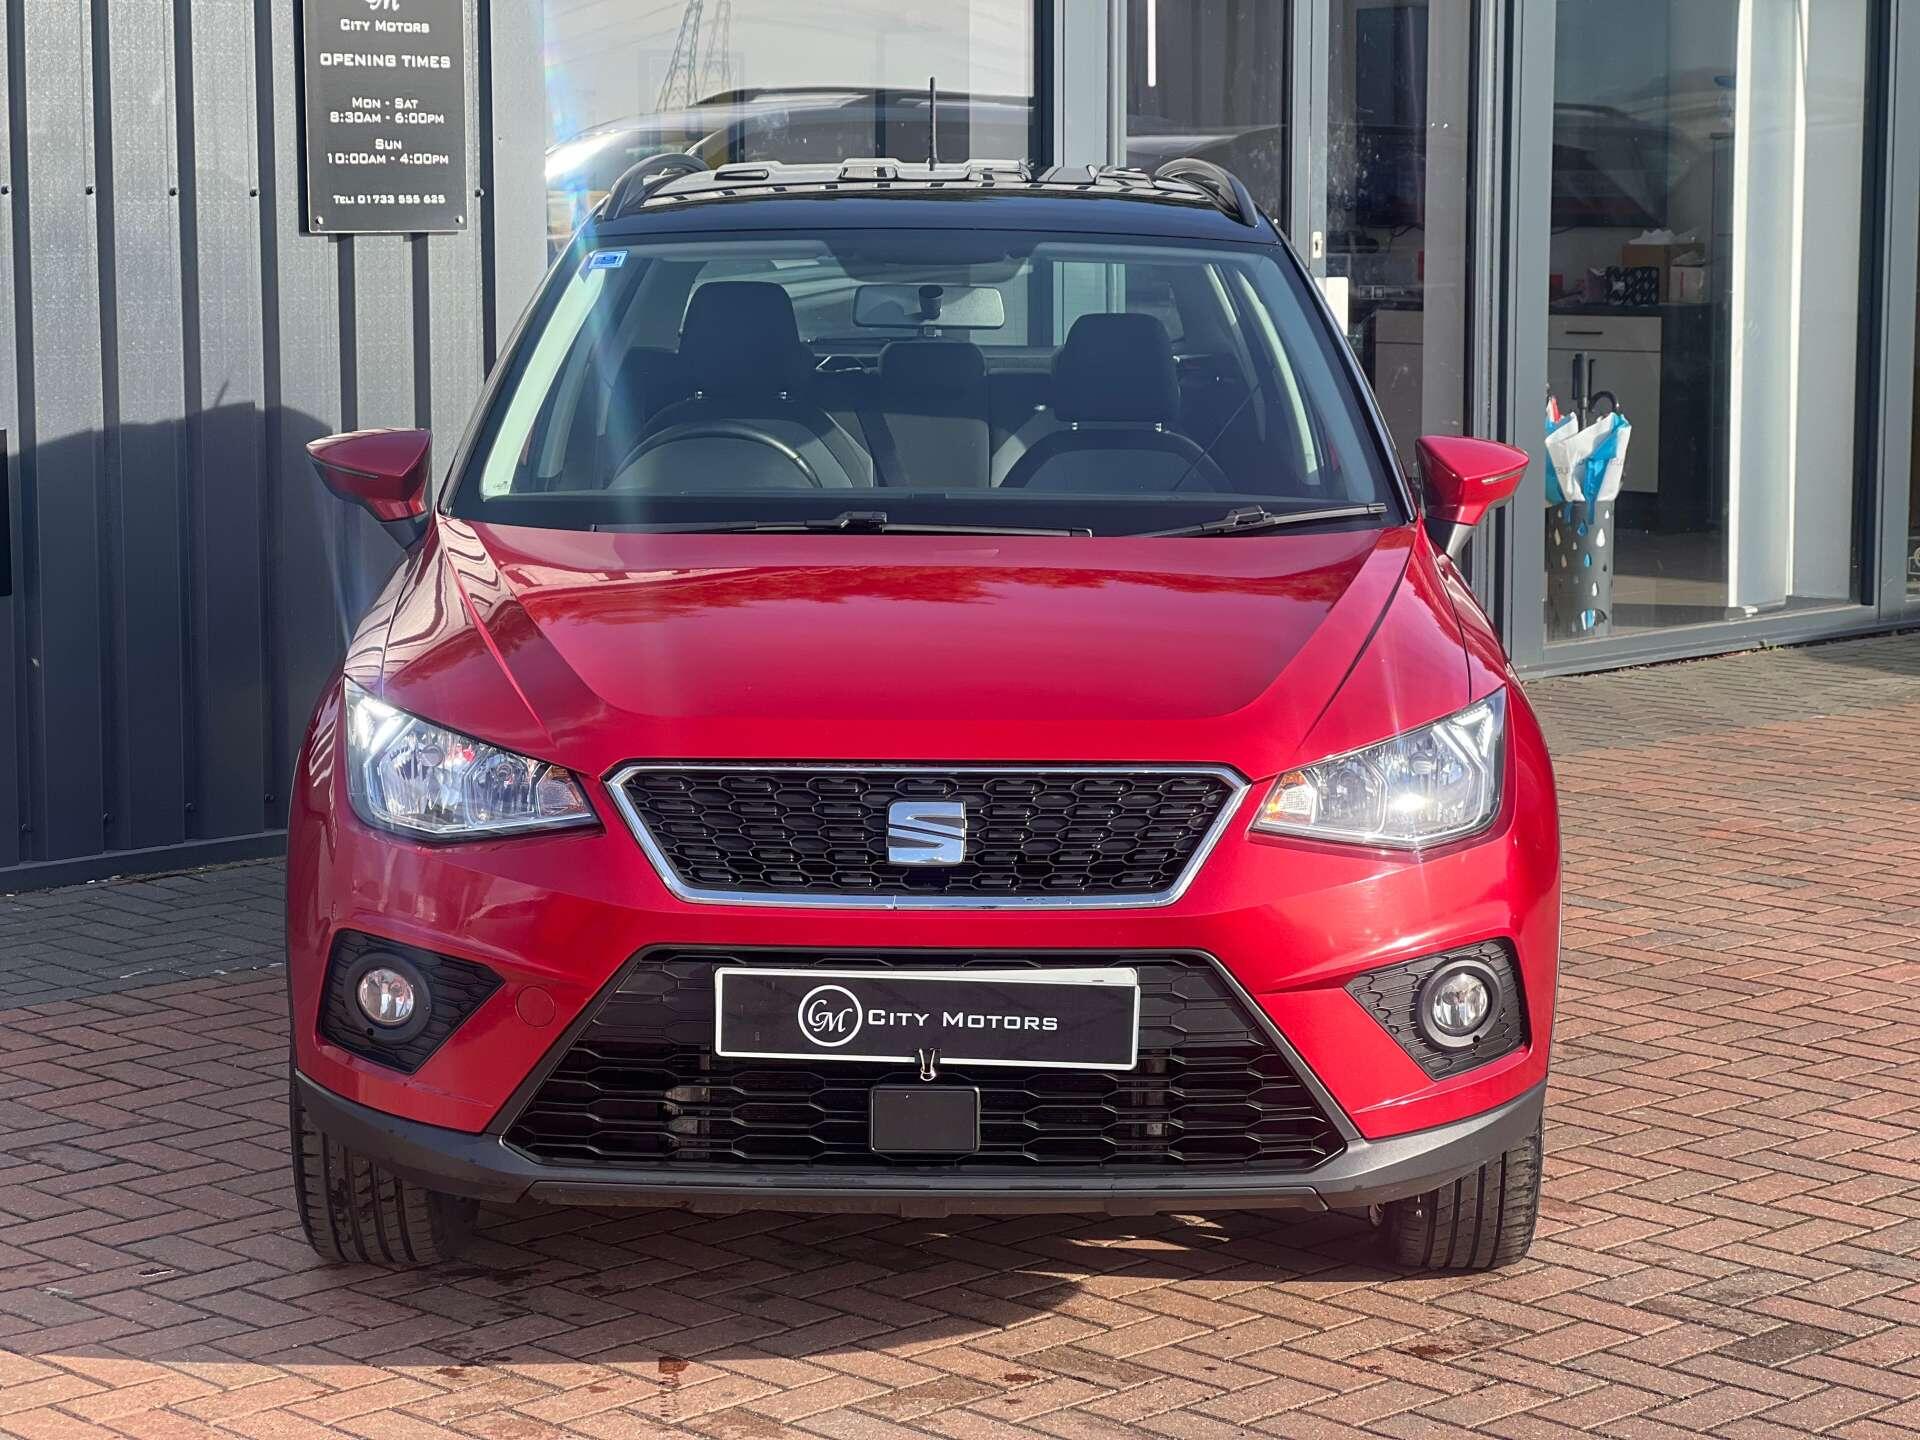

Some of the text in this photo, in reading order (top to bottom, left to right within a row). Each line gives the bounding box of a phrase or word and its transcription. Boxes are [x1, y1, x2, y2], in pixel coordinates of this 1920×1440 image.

[340, 18, 430, 34] CITY MOTORS
[319, 52, 451, 69] OPENING TIMES
[351, 97, 381, 109] MON
[394, 97, 419, 110] SAT
[329, 111, 381, 124] 8:30AM
[394, 112, 445, 124] 6:00PM
[375, 138, 403, 150] SUN
[327, 152, 386, 165] 10:00AM
[399, 152, 449, 165] 4:00PM
[357, 194, 395, 205] 01733
[868, 1009, 930, 1027] CITY
[942, 1011, 1058, 1031] MOTORS
